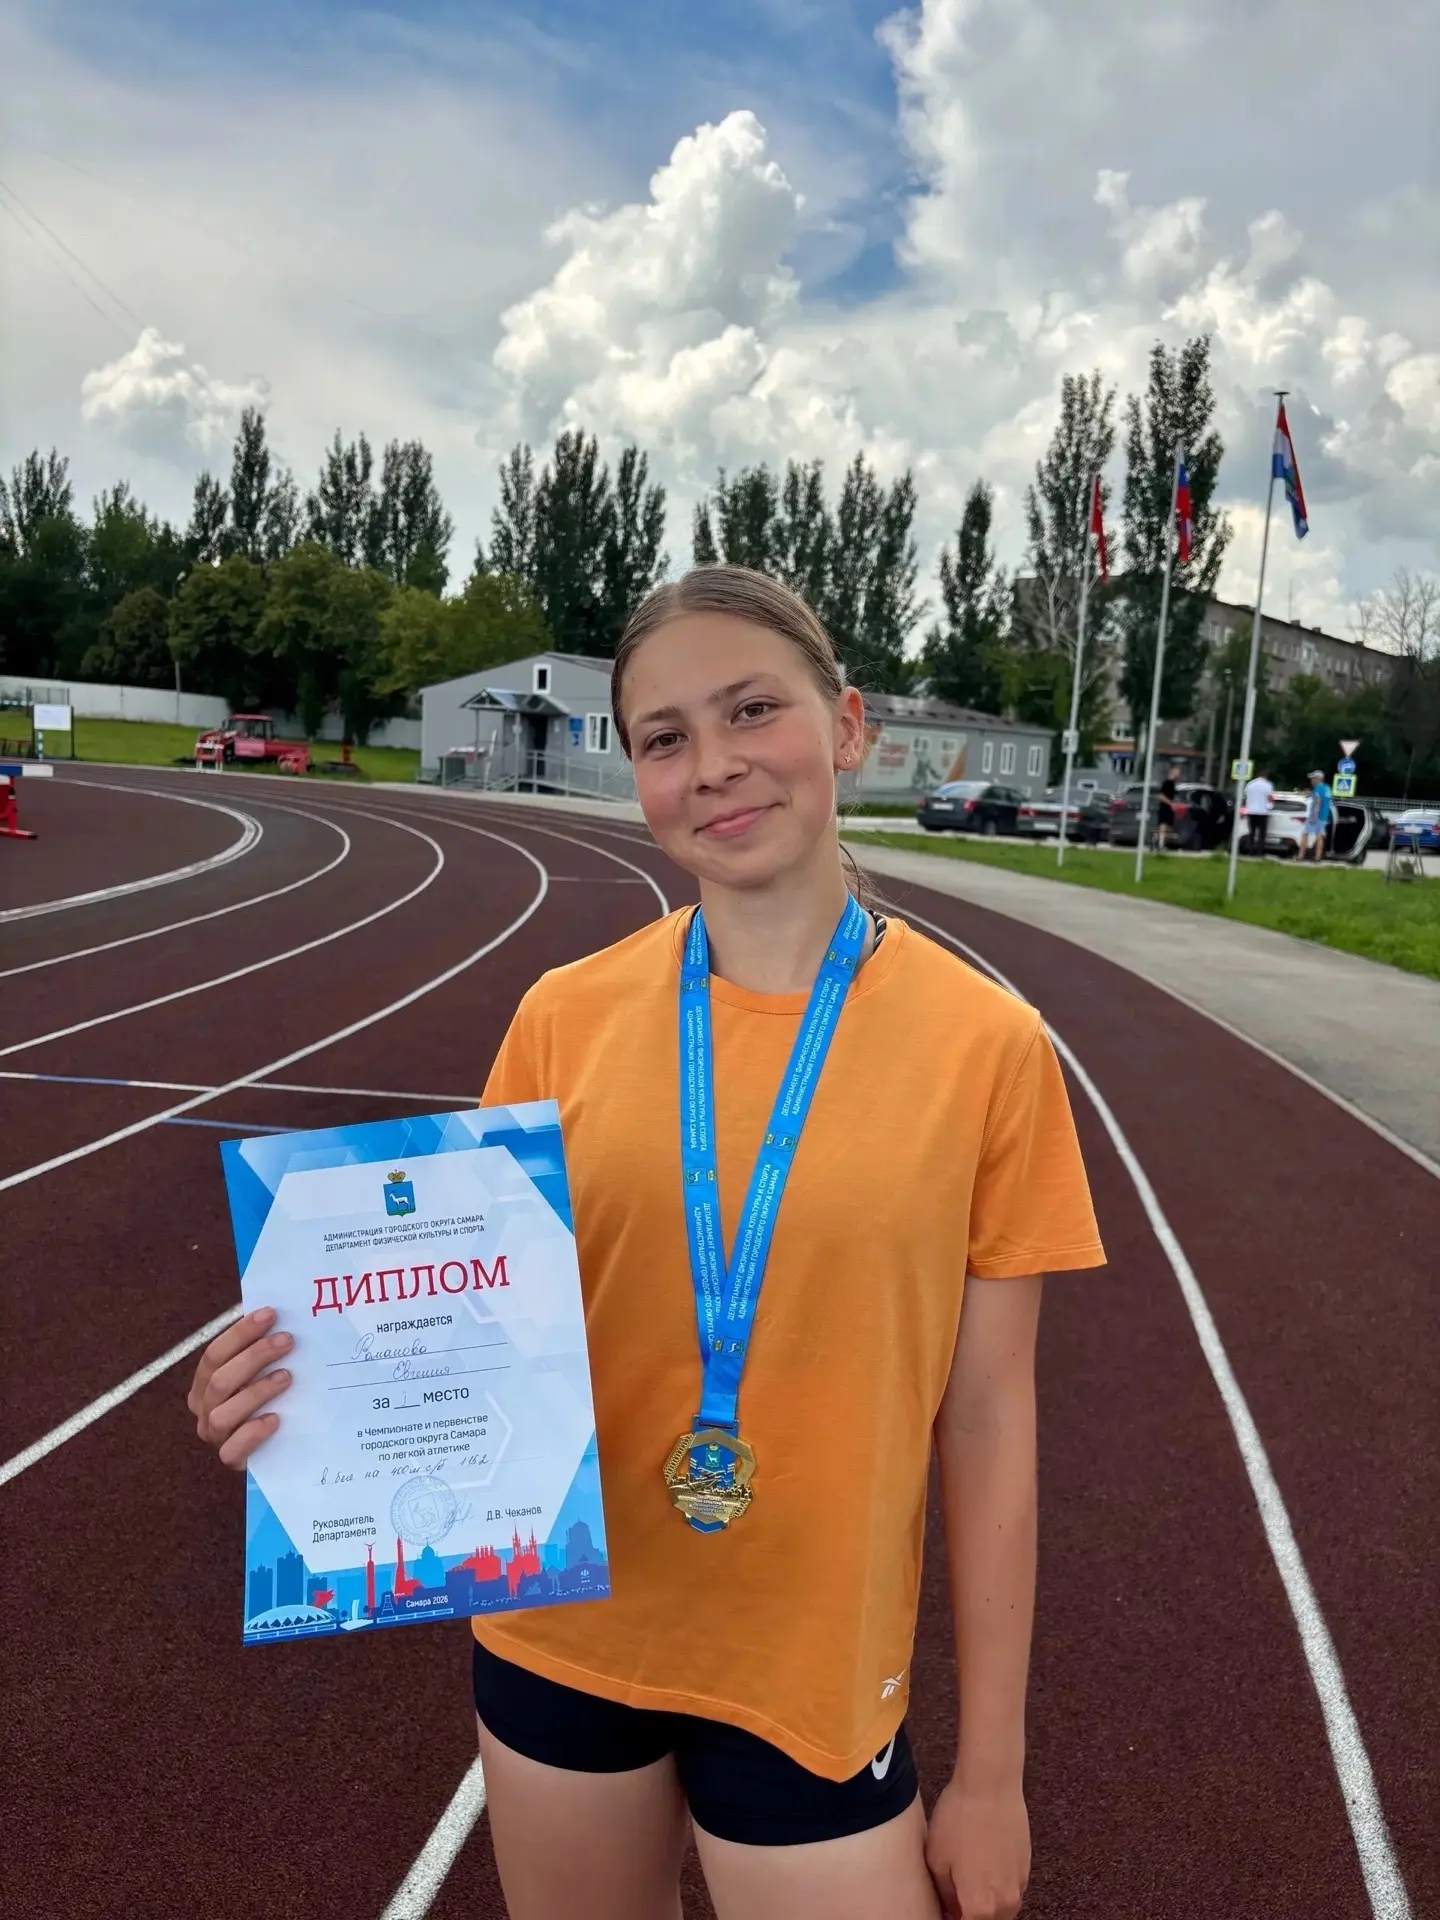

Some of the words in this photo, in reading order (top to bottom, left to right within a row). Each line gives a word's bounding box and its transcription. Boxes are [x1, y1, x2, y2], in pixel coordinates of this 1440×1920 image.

[781, 1073, 799, 1116] ДЕПАРТАМЕНТ
[795, 1032, 812, 1073] ФИЗИЧЕСКОЙ
[809, 1003, 823, 1033] КУЛЬТУРЫ
[821, 976, 832, 998] СПОРТА
[792, 1062, 813, 1114] АДМИНИСТРАЦИИ
[809, 1024, 825, 1063] ГОРОДСКОГО
[822, 1003, 832, 1025] ОКРУГА
[829, 982, 840, 1004] САМАРА
[324, 1228, 383, 1242] АДМИНИСТРАЦИЯ
[384, 1222, 429, 1234] ГОРОДСКОГО
[430, 1218, 455, 1228] ОКРУГА
[457, 1214, 484, 1224] САМАРА
[326, 1240, 371, 1252] ДЕПАРТАМЕНТ
[372, 1233, 417, 1246] ФИЗИЧЕСКОЙ
[419, 1229, 451, 1240] КУЛЬТУРЫ
[460, 1224, 484, 1234] СПОРТА
[694, 1206, 705, 1264] АДМИНИСТРАЦИИ
[703, 1202, 713, 1249] ДЕПАРТАМЕНТ
[727, 1273, 742, 1320] ДЕПАРТАМЕНТ
[738, 1228, 752, 1273] ФИЗИЧЕСКОЙ
[749, 1194, 761, 1228] КУЛЬТУРЫ
[759, 1163, 770, 1188] СПОРТА
[738, 1261, 755, 1319] АДМИНИСТРАЦИИ
[751, 1218, 765, 1261] ГОРОДСКОГО
[761, 1194, 771, 1219] ОКРУГА
[767, 1168, 779, 1195] САМАРА
[312, 1255, 510, 1316] ДИПЛОМ
[376, 1314, 453, 1333] награждается
[372, 1397, 390, 1410] за
[423, 1387, 470, 1403] место
[358, 1430, 363, 1438] в
[364, 1424, 423, 1437] Чемпионате
[425, 1422, 431, 1430] и
[433, 1414, 488, 1430] первенстве
[361, 1438, 415, 1452] городского
[417, 1432, 448, 1445] округа
[450, 1428, 486, 1440] Самара
[379, 1452, 390, 1462] по
[392, 1447, 425, 1459] легкой
[428, 1443, 470, 1456] атлетике
[312, 1515, 374, 1530] Руководитель
[487, 1510, 503, 1522] Д.В.
[506, 1506, 542, 1518] Чеканов
[312, 1526, 377, 1544] Департамента
[406, 1598, 431, 1608] Самара
[433, 1595, 449, 1604] 2026
